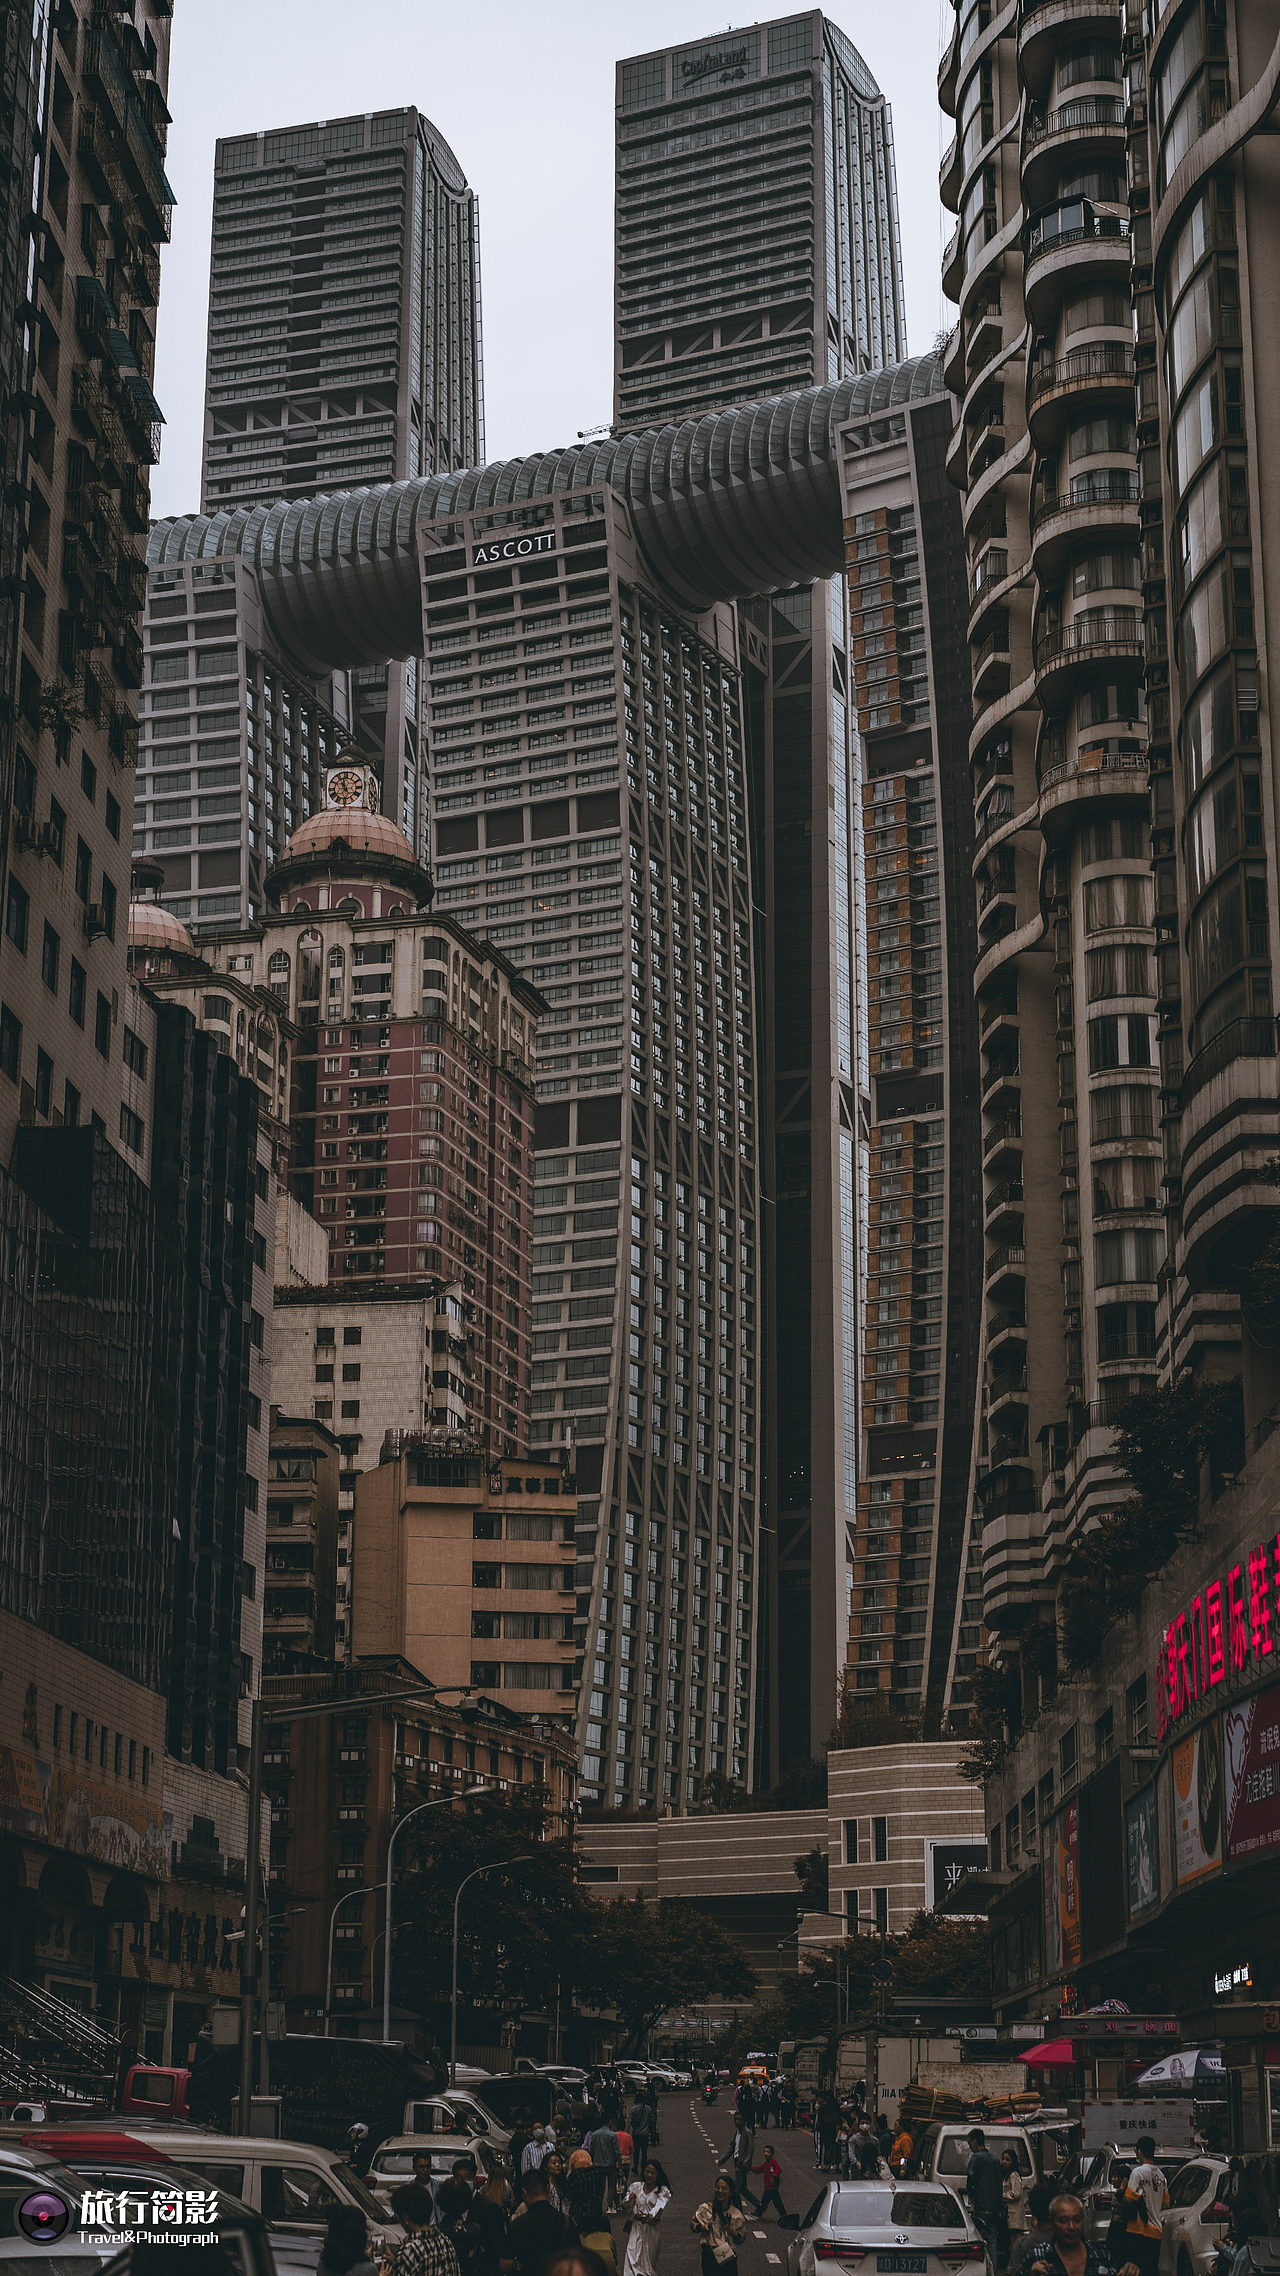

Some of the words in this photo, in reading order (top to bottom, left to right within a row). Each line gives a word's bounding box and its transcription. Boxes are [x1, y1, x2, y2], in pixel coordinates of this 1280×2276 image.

[682, 46, 747, 77] CapitaLand
[474, 533, 555, 563] ASCOTT
[1105, 2021, 1176, 2032] 刘一碗面
[1119, 2120, 1157, 2129] 重庆快递
